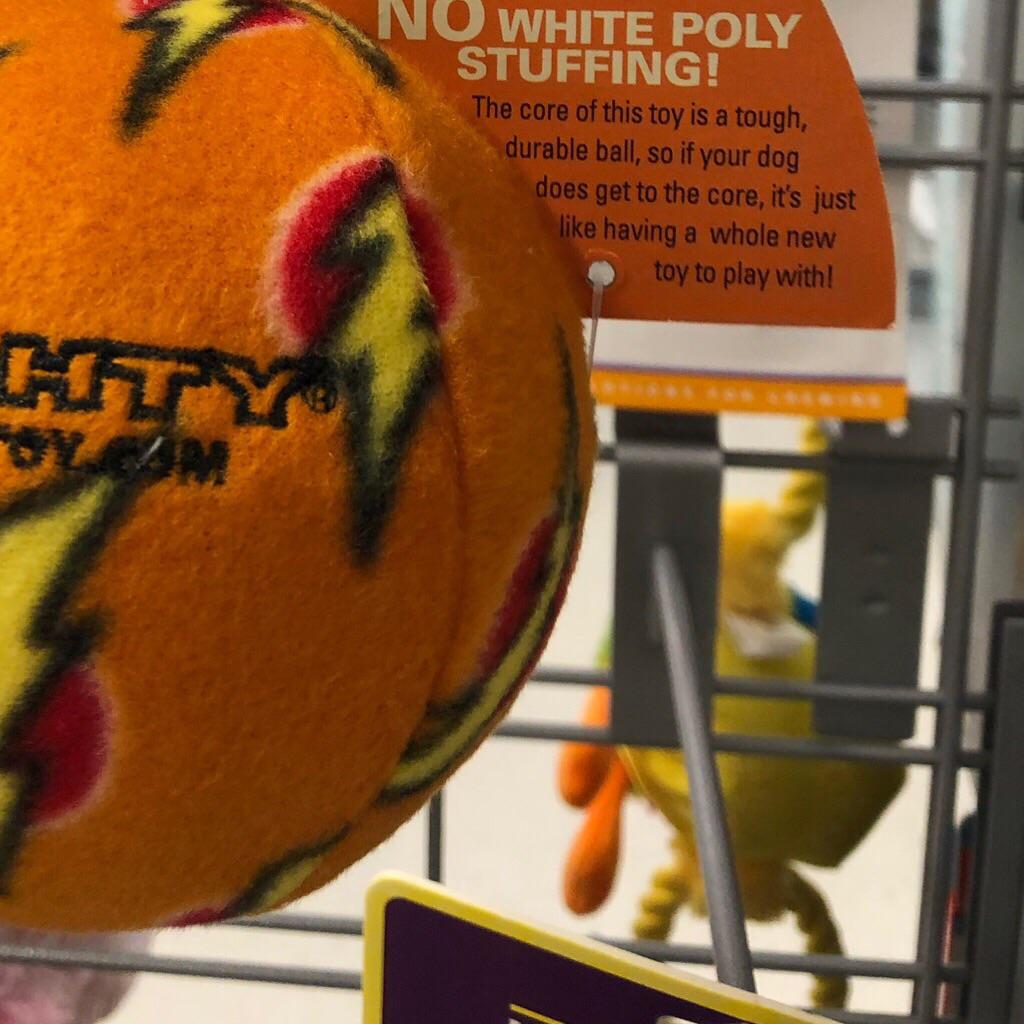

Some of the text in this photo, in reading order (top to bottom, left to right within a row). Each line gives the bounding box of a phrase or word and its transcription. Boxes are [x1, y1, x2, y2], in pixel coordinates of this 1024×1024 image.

[498, 8, 654, 46] WHITE
[671, 12, 803, 49] POLY
[457, 45, 719, 87] STUFFING!
[472, 95, 808, 134] The core of this toy is a tough,
[505, 135, 799, 174] durable ball, so if your dog
[536, 175, 856, 214] does get to the core, it's just
[560, 215, 836, 249] like having a whole new
[655, 261, 833, 291] toy to play with!
